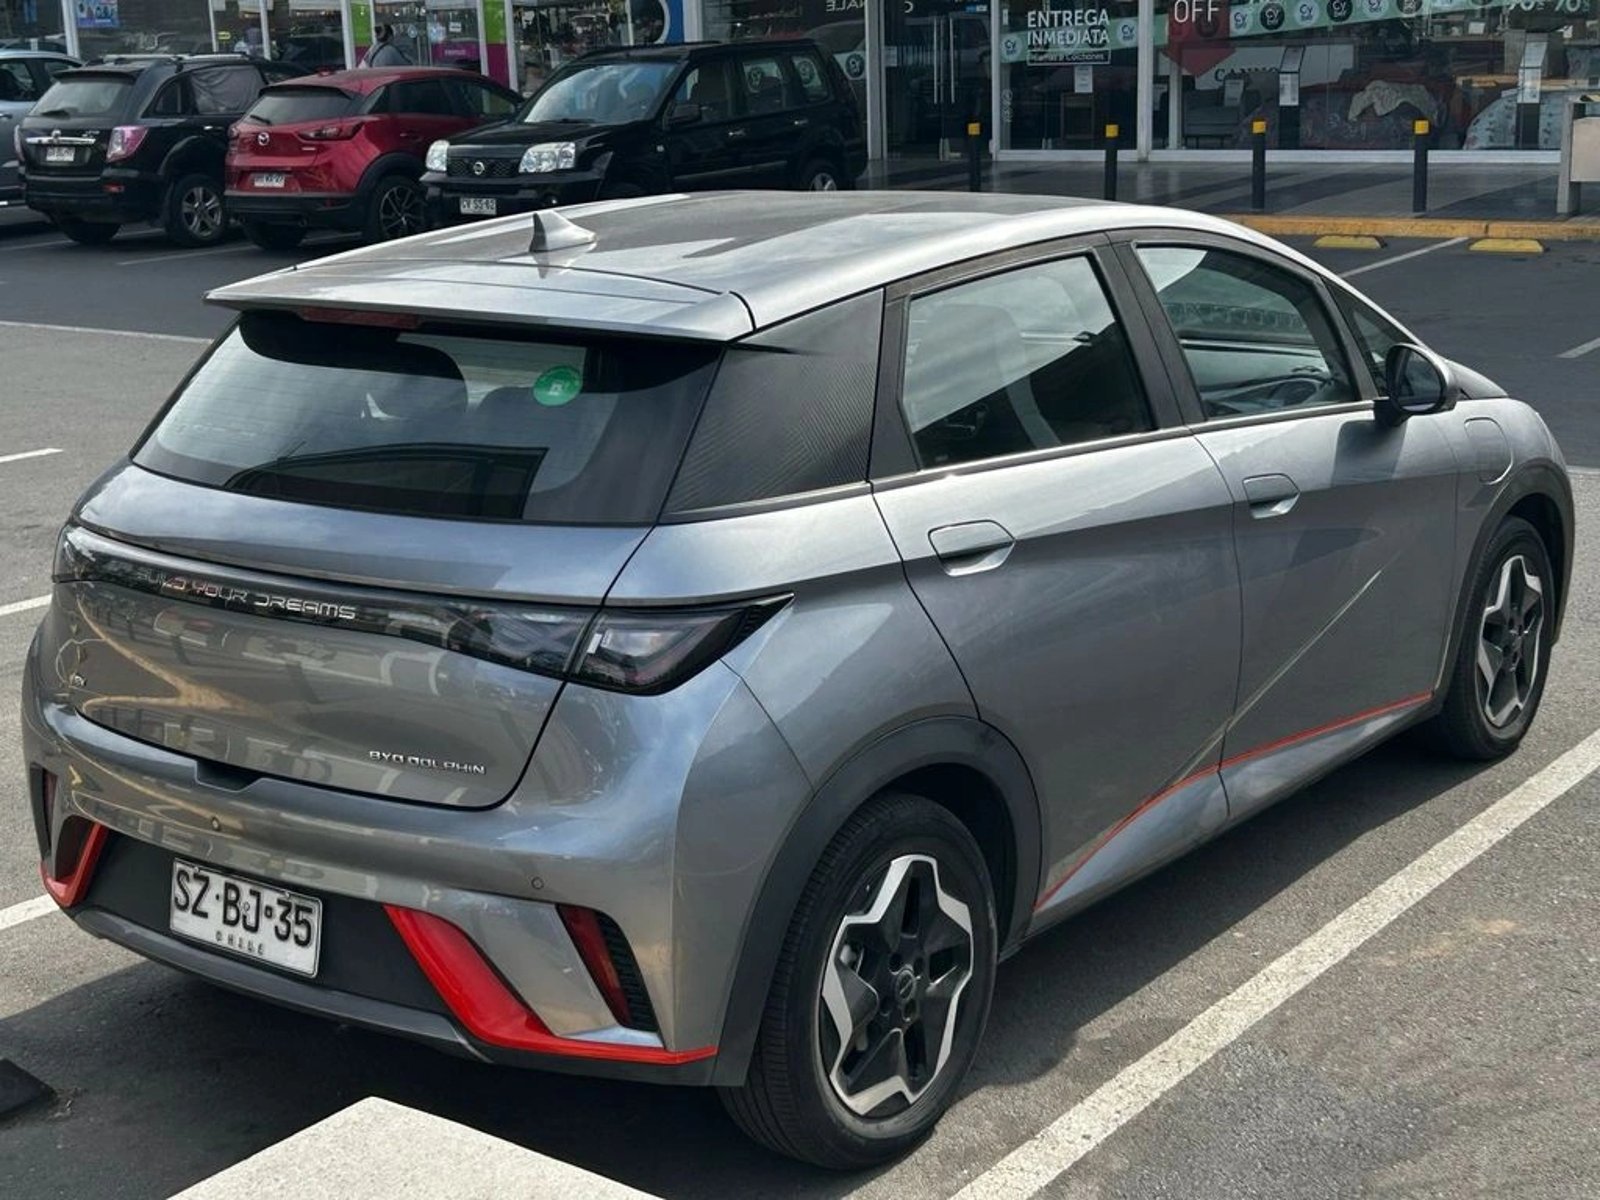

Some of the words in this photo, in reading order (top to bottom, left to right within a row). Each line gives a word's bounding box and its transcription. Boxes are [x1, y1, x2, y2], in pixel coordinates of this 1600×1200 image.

[1027, 8, 1110, 27] ENTREGA
[1174, 0, 1219, 23] OFF
[1027, 28, 1110, 46] INMEDIATA
[192, 580, 248, 603] YOUR
[254, 592, 357, 620] DREAMS
[369, 750, 405, 764] BYD
[407, 755, 485, 775] DOLPHIN
[215, 930, 264, 956] CHILE
